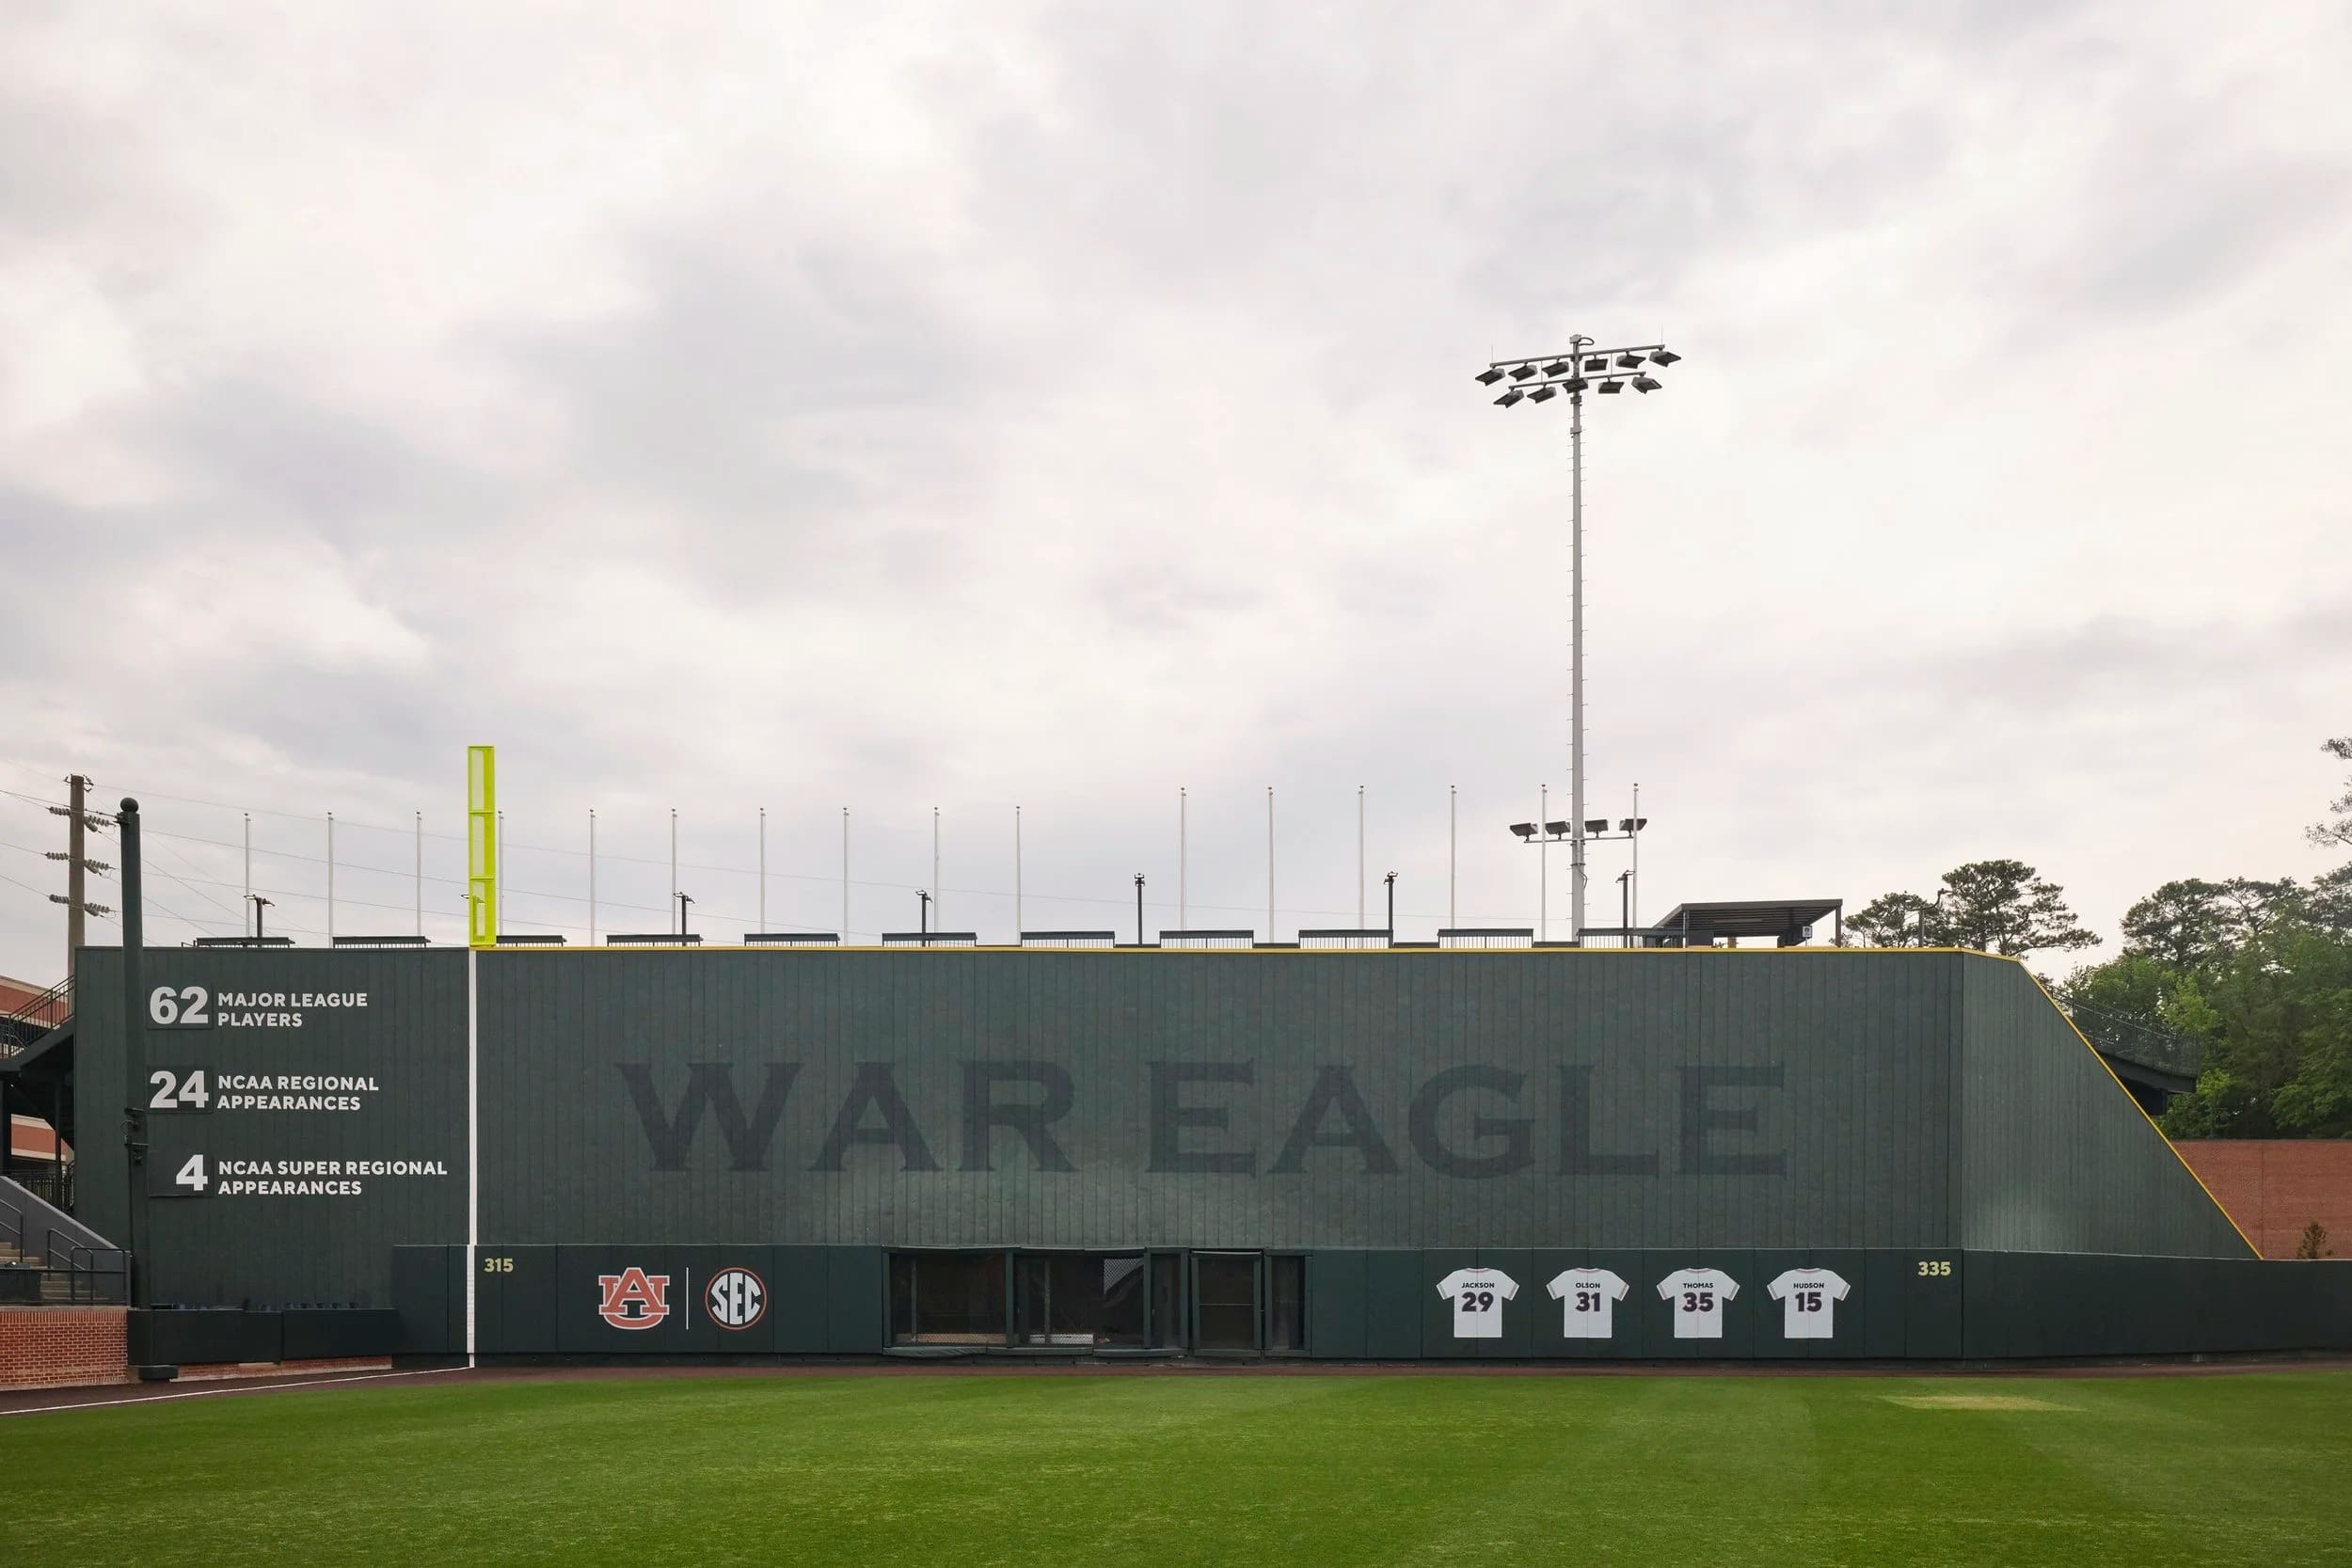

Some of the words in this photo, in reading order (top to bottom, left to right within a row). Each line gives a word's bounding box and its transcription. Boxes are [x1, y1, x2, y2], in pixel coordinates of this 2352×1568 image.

[151, 987, 208, 1024] 62
[218, 993, 285, 1006] MAJOR
[292, 993, 367, 1006] LEAGUE
[218, 1013, 302, 1027] PLAYERS
[150, 1070, 209, 1108] 24
[219, 1075, 273, 1089] NCAA
[278, 1076, 378, 1090] REGIONAL
[217, 1096, 360, 1110] APPEARANCES
[615, 1061, 1079, 1172] WAR
[1145, 1059, 1787, 1180] EAGLE
[176, 1155, 208, 1191] 4
[219, 1161, 273, 1175] NCAA
[278, 1161, 341, 1175] SUPER
[346, 1161, 447, 1175] REGIONAL
[218, 1181, 361, 1195] APPEARANCES
[485, 1259, 513, 1272] 315
[1918, 1261, 1950, 1275] 335
[711, 1272, 761, 1325] SEC
[1462, 1291, 1493, 1311] 29
[1576, 1291, 1600, 1311] 31
[1683, 1292, 1713, 1312] 35
[1795, 1292, 1821, 1312] 15
